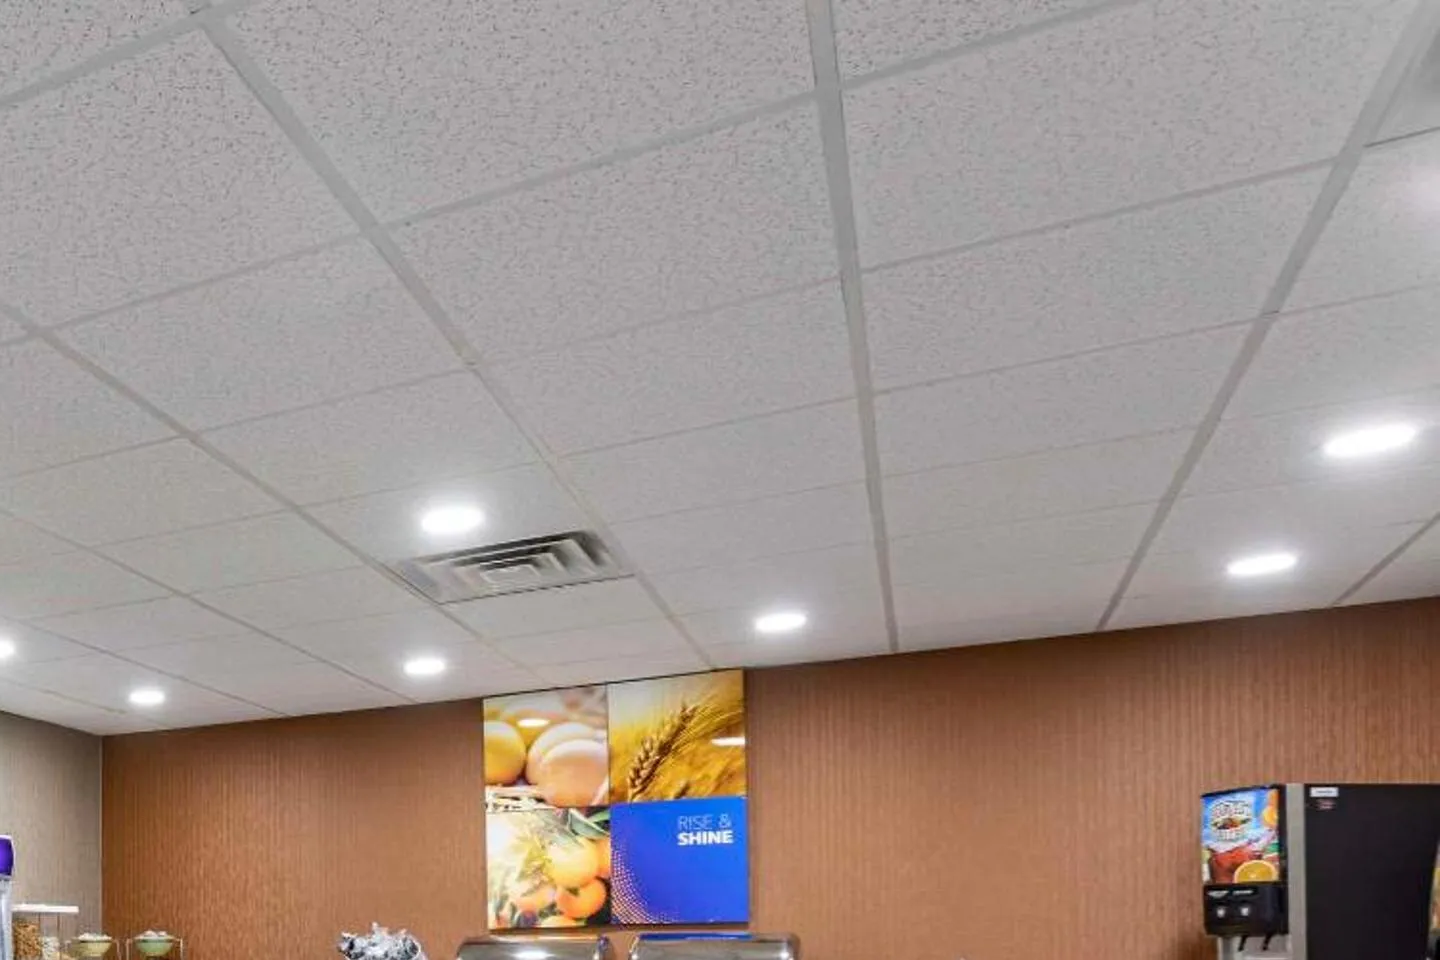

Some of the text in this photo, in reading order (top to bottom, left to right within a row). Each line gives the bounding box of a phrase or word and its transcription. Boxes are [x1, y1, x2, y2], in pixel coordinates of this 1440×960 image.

[678, 813, 732, 830] RISE &
[677, 830, 734, 846] SHINE
